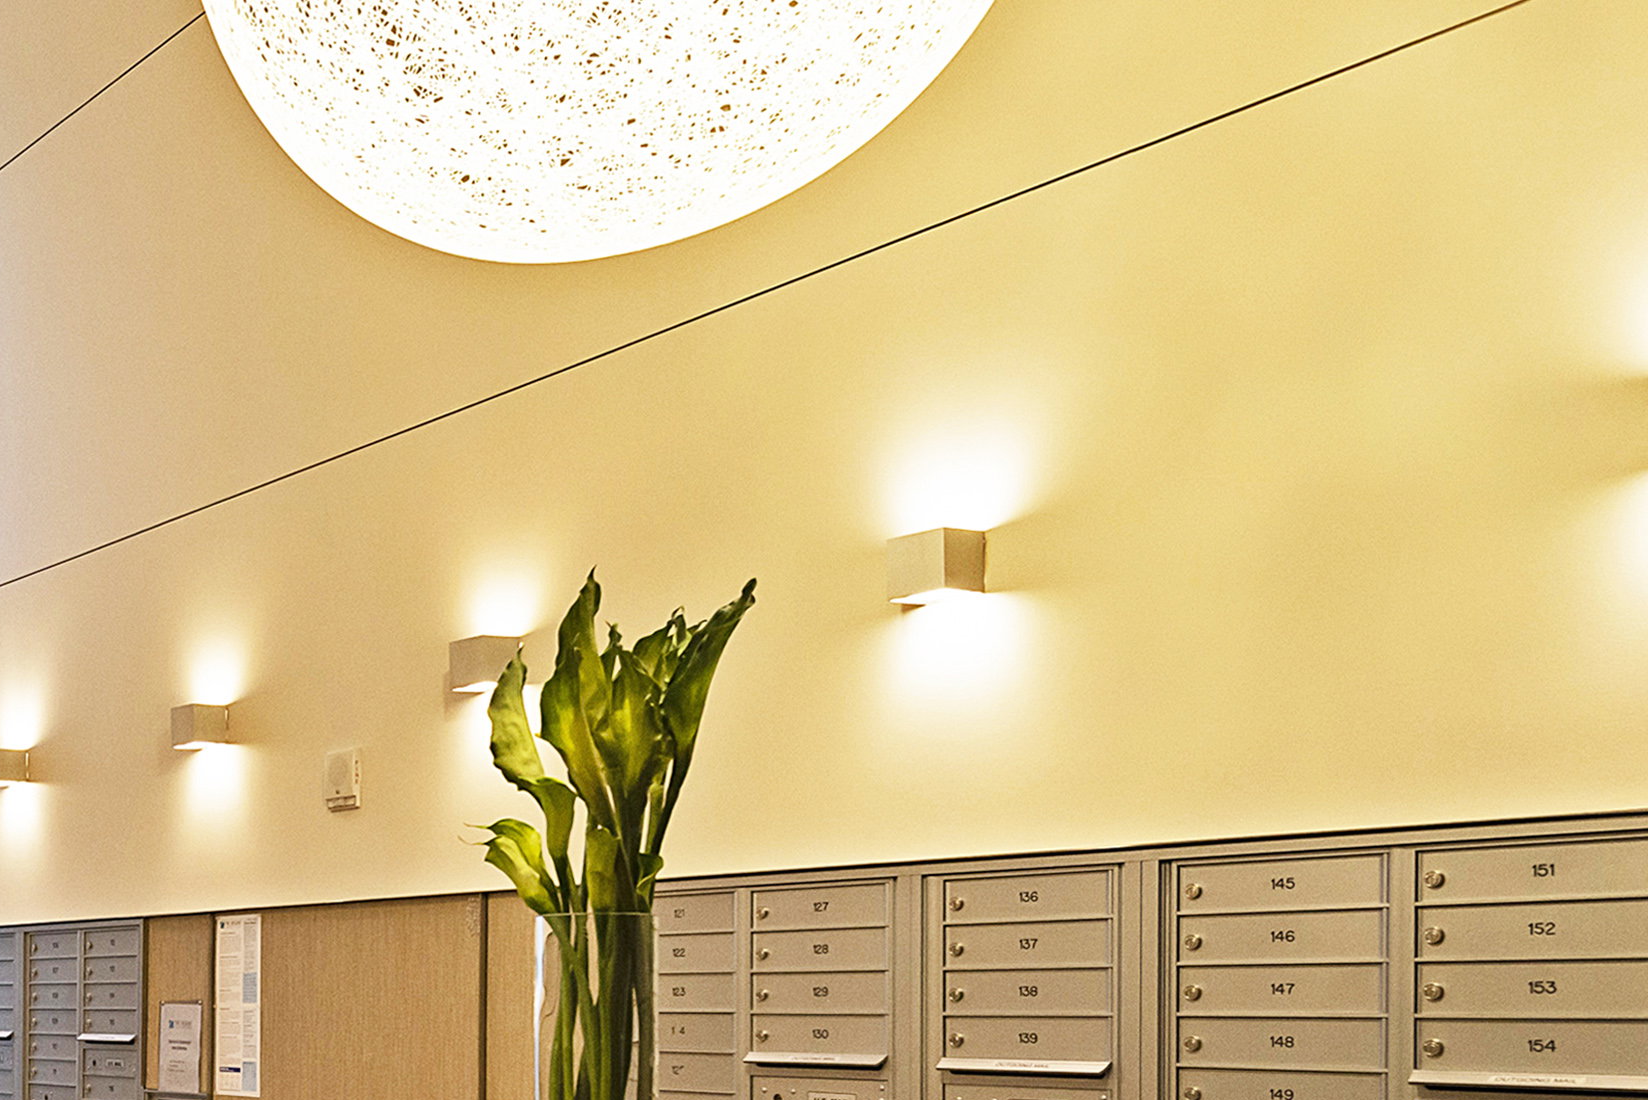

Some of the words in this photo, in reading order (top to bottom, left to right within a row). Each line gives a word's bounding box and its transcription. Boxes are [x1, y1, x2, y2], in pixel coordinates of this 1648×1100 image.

[1532, 864, 1554, 877] 151
[1272, 878, 1295, 889] 145
[1020, 891, 1038, 902] 136
[814, 902, 828, 912] 127
[1528, 922, 1555, 935] 152
[1271, 930, 1295, 942] 146
[813, 944, 828, 954] 128
[1020, 939, 1038, 949] 137
[673, 948, 685, 957] 122
[672, 987, 685, 996] 123
[813, 987, 828, 997] 129
[1019, 986, 1038, 997] 138
[1271, 983, 1295, 994] 147
[1529, 981, 1557, 994] 153
[671, 1026, 686, 1035] 14
[812, 1029, 829, 1039] 130
[1019, 1033, 1038, 1044] 139
[1270, 1036, 1294, 1048] 148
[1528, 1040, 1556, 1052] 154
[1270, 1089, 1294, 1100] 149
